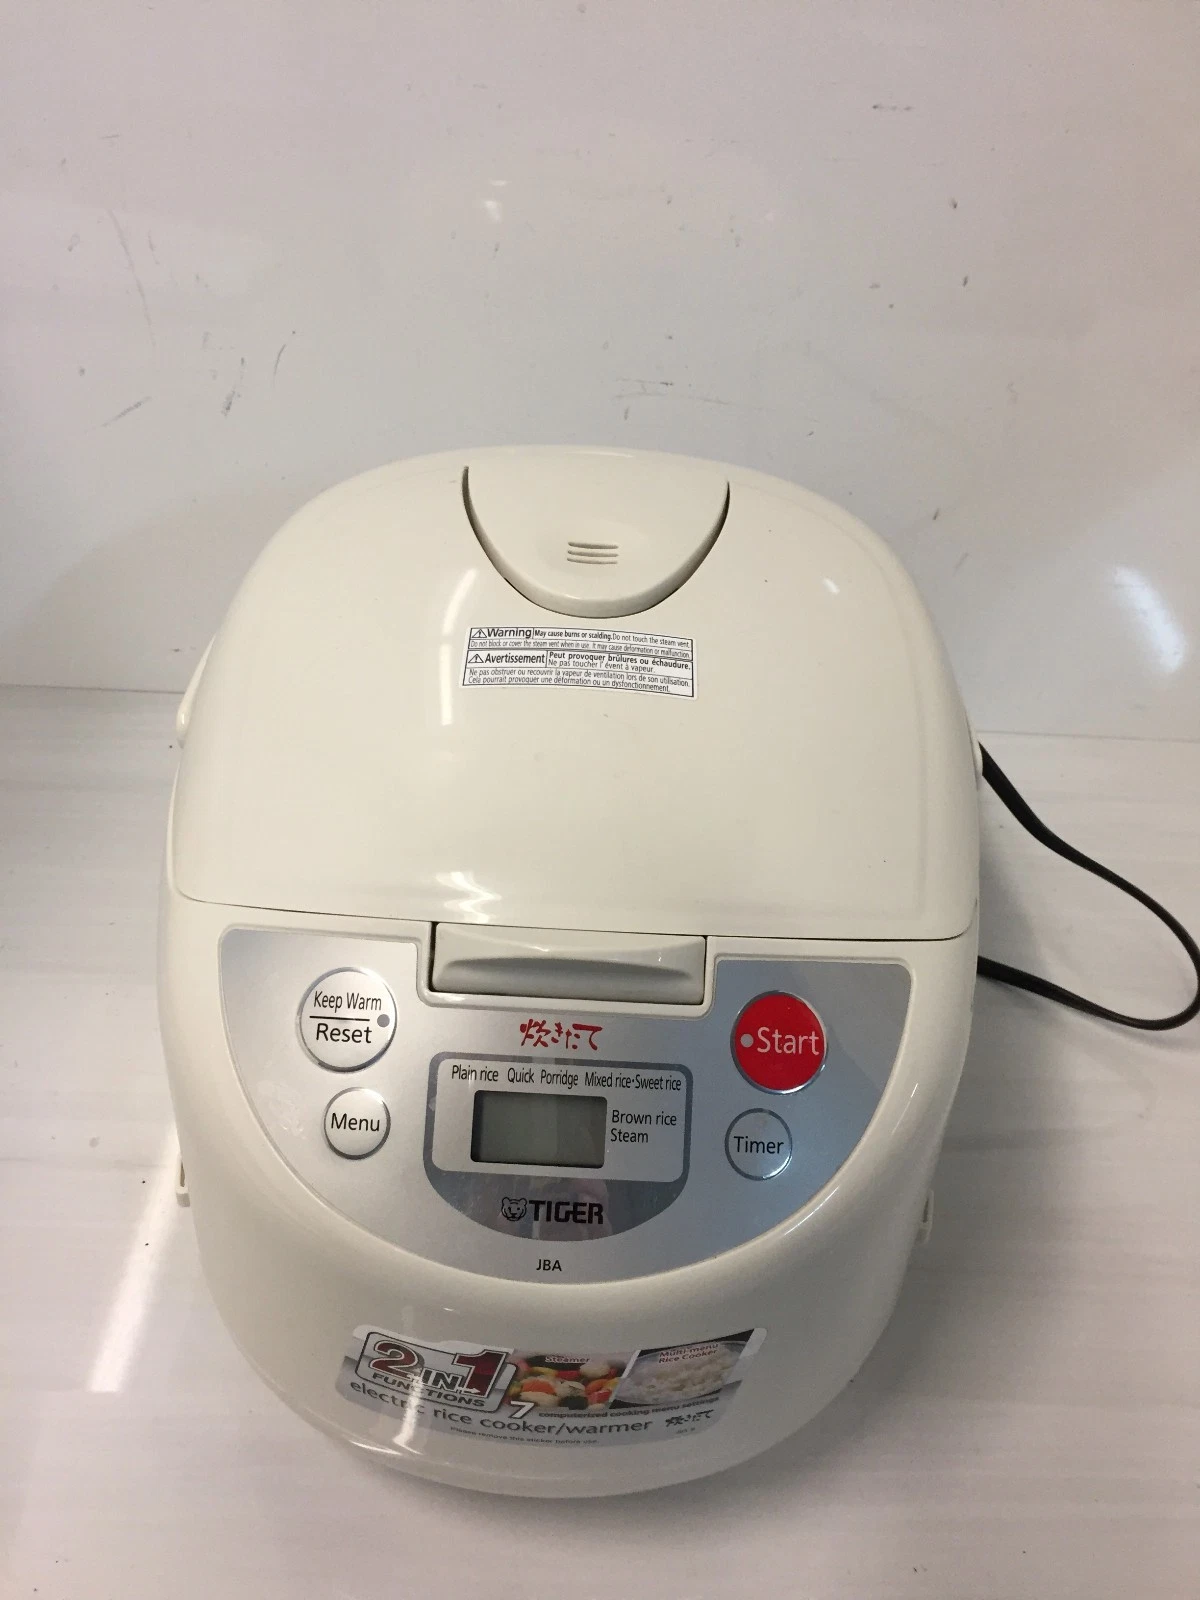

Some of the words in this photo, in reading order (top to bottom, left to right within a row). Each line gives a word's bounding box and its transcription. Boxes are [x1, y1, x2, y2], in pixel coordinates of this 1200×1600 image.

[487, 628, 532, 639] Warning
[535, 629, 546, 638] May
[565, 630, 580, 638] burns
[632, 635, 647, 643] touch
[597, 643, 607, 651] may
[624, 645, 654, 654] deformation
[485, 652, 545, 664] Avertissement
[548, 659, 558, 667] Ne
[559, 660, 571, 668] pas
[572, 660, 598, 669] toucher
[549, 651, 566, 659] Peut
[569, 653, 606, 662] provoquer
[608, 653, 638, 664] brûlures
[652, 657, 690, 670] échaudure.
[468, 675, 482, 684] Cela
[483, 676, 507, 685] pourrait
[509, 676, 540, 685] provoquer
[554, 676, 592, 685] déformation
[469, 668, 478, 676] Ne
[479, 669, 490, 677] pas
[491, 668, 516, 676] obstruer
[562, 669, 582, 678] vapeur
[584, 669, 592, 678] de
[593, 671, 625, 680] ventilation
[627, 672, 638, 681] lors
[639, 674, 647, 682] de
[313, 990, 343, 1014] Keep
[346, 992, 382, 1011] Warm
[316, 1022, 373, 1044] Reset
[519, 1018, 603, 1051] 炊きたて
[757, 1026, 820, 1056] Start
[451, 1064, 477, 1081] Plain
[480, 1065, 499, 1082] rice
[507, 1067, 535, 1084] Quick
[540, 1069, 579, 1090] Porridge
[584, 1071, 613, 1088] Mixed
[665, 1075, 682, 1092] rice
[330, 1112, 381, 1132] Menu
[611, 1109, 652, 1126] Brown
[655, 1111, 677, 1126] rice
[610, 1128, 649, 1143] Steam
[733, 1135, 785, 1155] Timer
[528, 1199, 604, 1225] TIGER
[536, 1258, 562, 1272] JBA
[544, 1355, 590, 1365] Steamer
[658, 1355, 680, 1365] Rice
[681, 1348, 719, 1362] Cooker
[371, 1372, 486, 1408] FUNTIONS
[350, 1381, 426, 1415] electrc
[433, 1408, 472, 1426] rice
[479, 1418, 654, 1436] cooker/warmer
[507, 1400, 536, 1420] 7
[538, 1411, 609, 1420] computerized
[609, 1408, 650, 1418] cooking
[651, 1404, 681, 1414] menu
